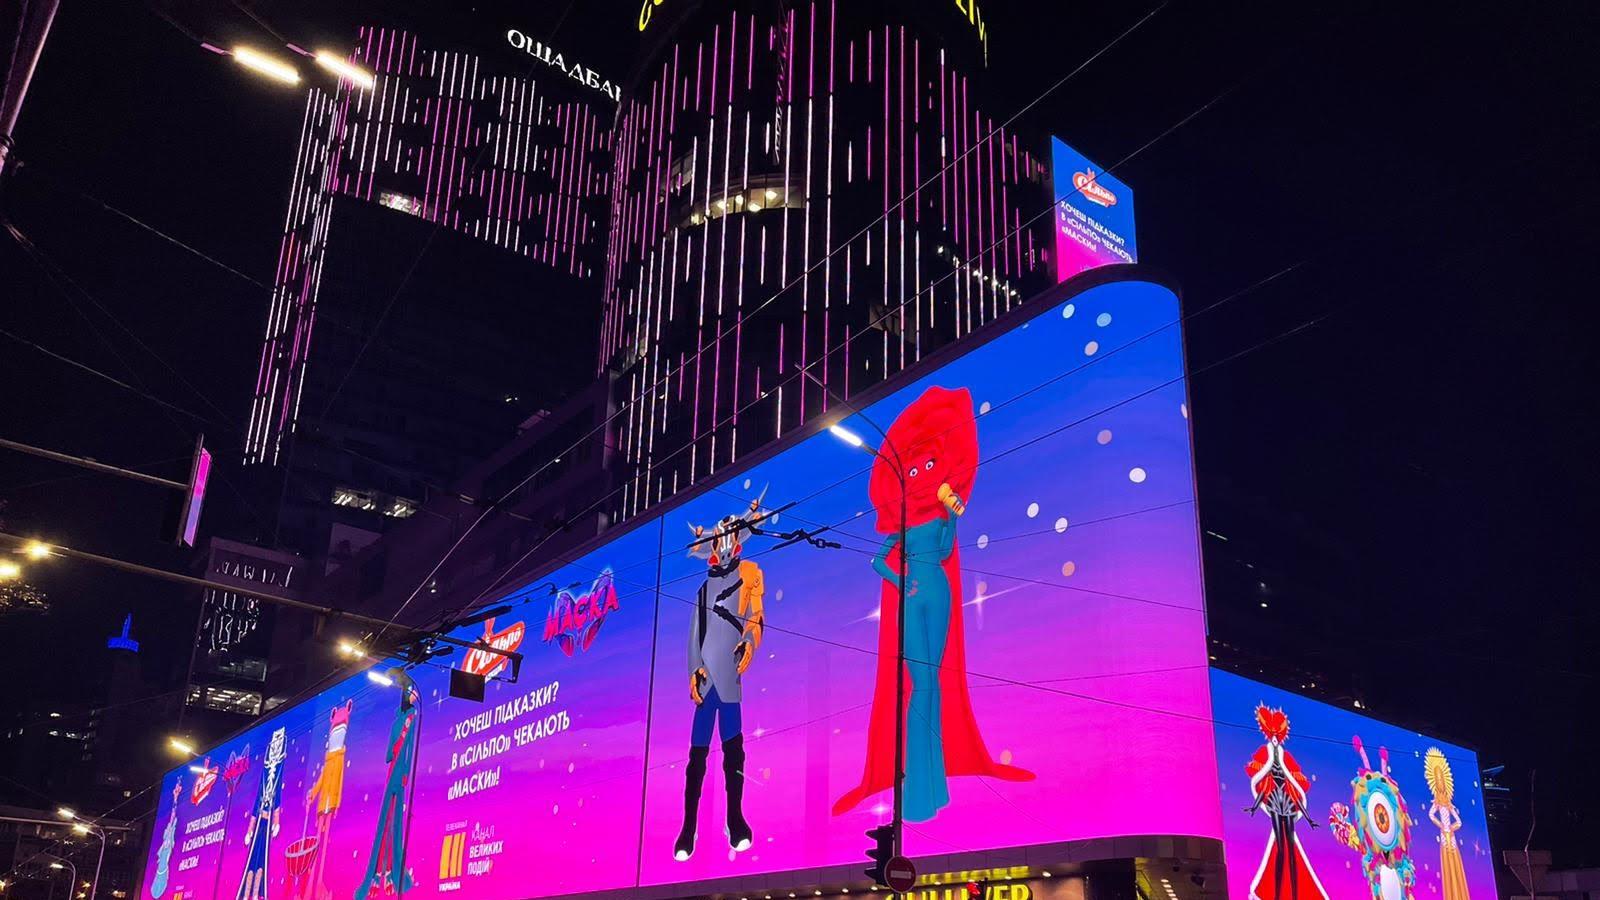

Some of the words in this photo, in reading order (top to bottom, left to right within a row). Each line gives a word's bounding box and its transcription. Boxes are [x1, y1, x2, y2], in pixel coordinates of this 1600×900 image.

[1060, 200, 1087, 222] ХОЧЕШ
[1087, 217, 1125, 247] ПІДКАЗКИ?
[454, 709, 492, 742] ХОЧЕШ
[494, 681, 560, 726] ПІДКАЗКИ?
[451, 753, 458, 771] В
[459, 734, 511, 769] «СІЛЬПО»
[513, 710, 571, 747] ЧЕКАЮТЬ
[447, 766, 501, 801] «МАСКИ»!
[469, 840, 504, 859] ВЕЛИКИХ
[471, 822, 495, 842] КАНАЛ
